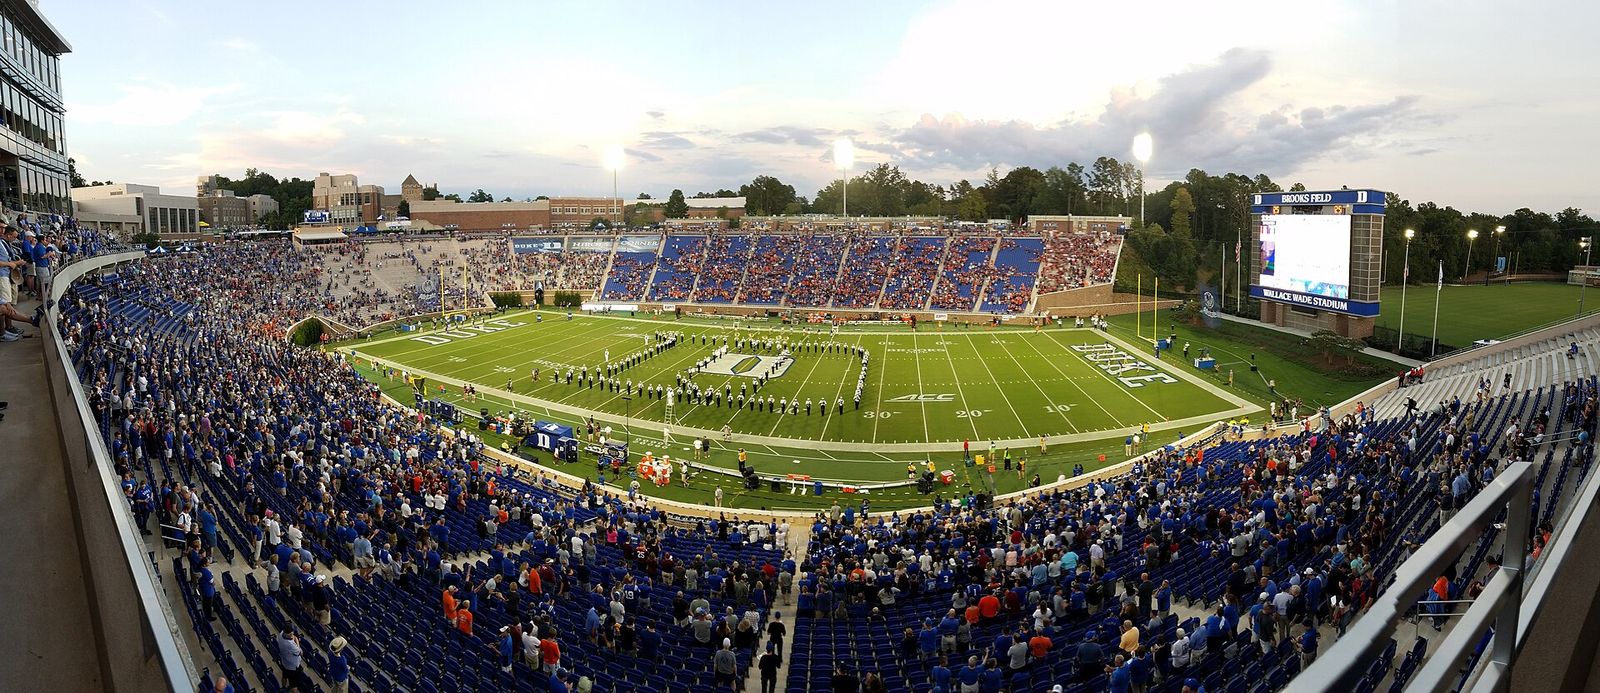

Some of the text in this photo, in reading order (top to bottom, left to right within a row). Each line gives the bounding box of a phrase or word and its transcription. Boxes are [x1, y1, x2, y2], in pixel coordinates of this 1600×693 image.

[1254, 194, 1262, 204] D
[1281, 193, 1332, 203] BROOKS FIELD
[1357, 191, 1368, 203] D
[1263, 289, 1348, 311] WALLACE WADE STADIUM
[409, 319, 528, 345] DUKE
[1070, 341, 1179, 388] DUKE
[1042, 403, 1071, 413] 10
[863, 411, 892, 419] 30
[955, 410, 983, 418] 20
[537, 432, 550, 449] D
[943, 575, 949, 583] 3
[624, 590, 634, 600] 19
